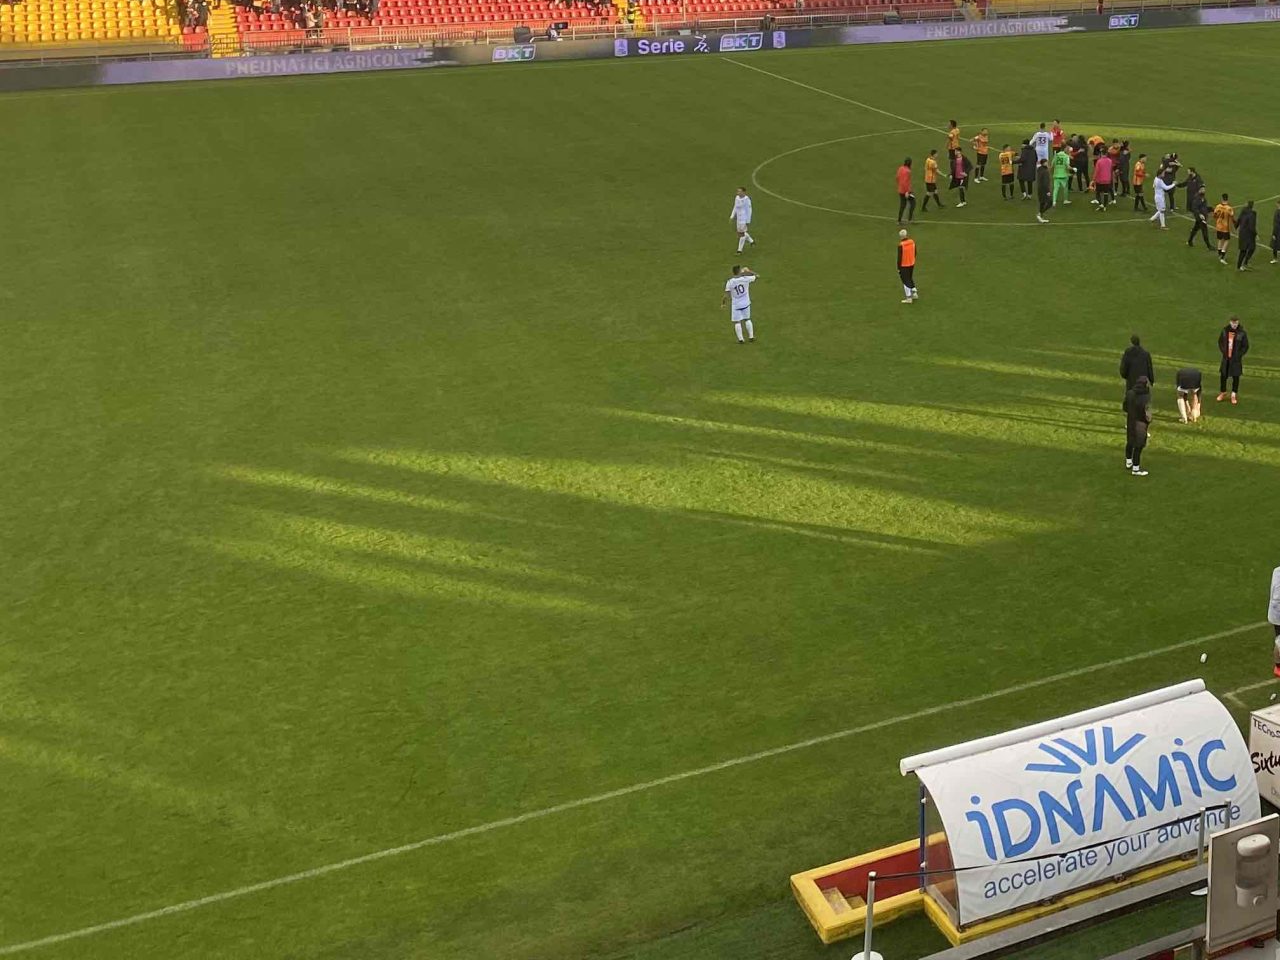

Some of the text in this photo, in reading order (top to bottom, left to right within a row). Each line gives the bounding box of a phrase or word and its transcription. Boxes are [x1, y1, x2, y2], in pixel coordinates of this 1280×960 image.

[926, 21, 998, 38] PNEUMATICI
[1110, 15, 1138, 27] BKT
[495, 47, 533, 59] BKT
[637, 34, 761, 55] Serie BKT
[225, 52, 330, 76] PNEUMATICI
[733, 283, 745, 296] 10
[984, 848, 1098, 900] accelerate
[1104, 831, 1151, 866] your
